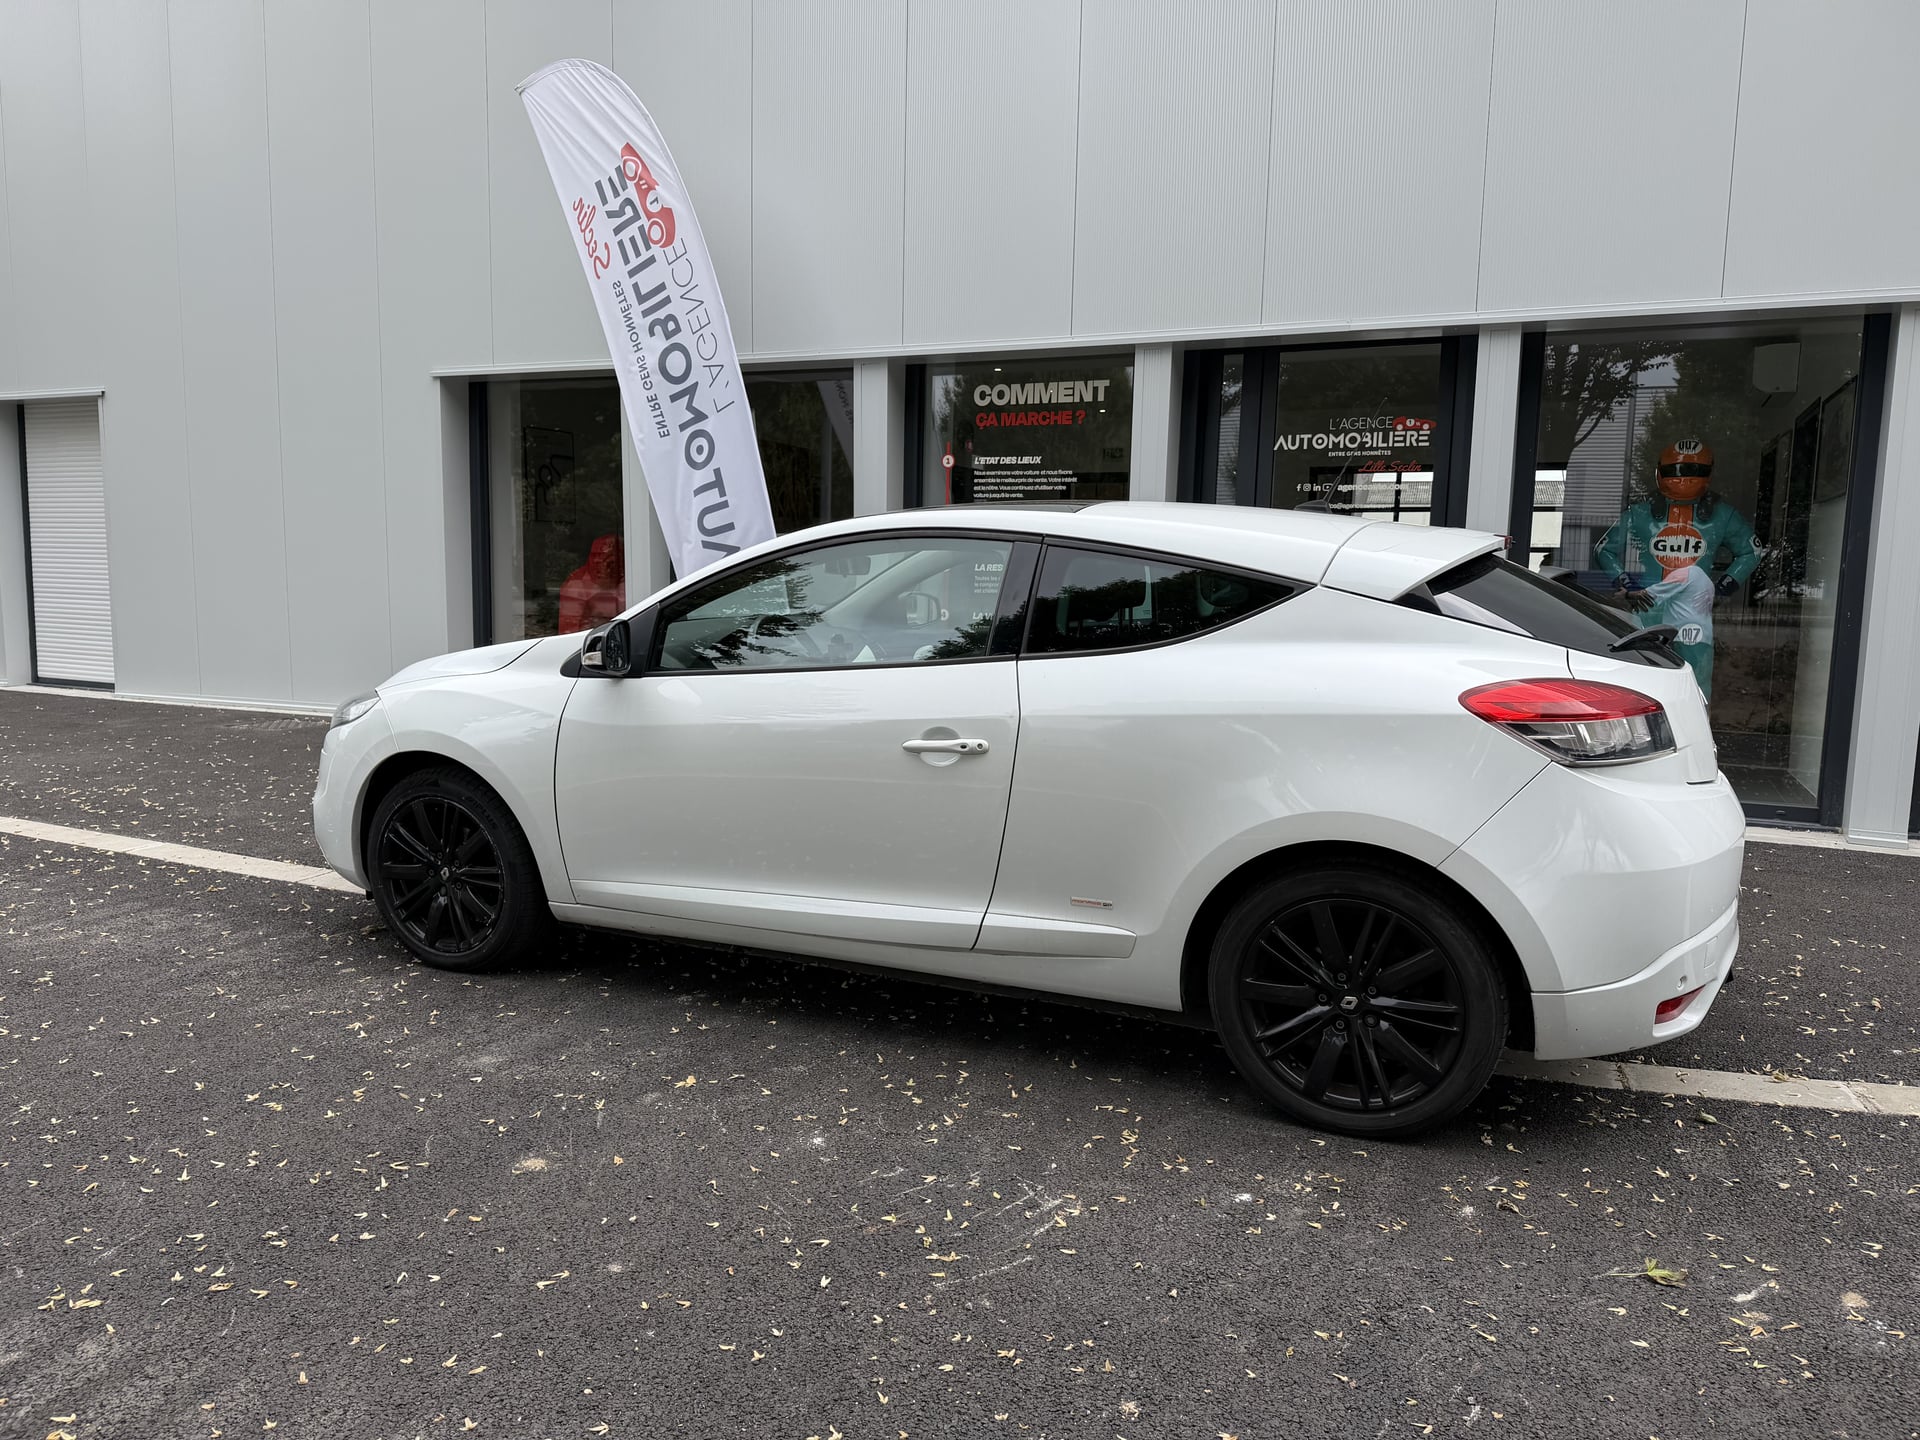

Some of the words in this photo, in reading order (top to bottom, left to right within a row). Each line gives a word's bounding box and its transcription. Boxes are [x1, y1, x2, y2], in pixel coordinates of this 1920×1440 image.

[973, 379, 1110, 407] COMMENT
[975, 412, 998, 430] ÇA
[1001, 410, 1073, 427] MARCHE
[1076, 409, 1087, 425] ?
[1329, 416, 1393, 431] L'AGENCE
[974, 456, 1000, 465] L'ETAT
[1000, 456, 1017, 465] DES
[1017, 456, 1042, 465] LIEUX
[1388, 459, 1422, 472] Seclin
[1653, 539, 1703, 554] Gulf
[974, 563, 986, 572] LA
[1681, 627, 1701, 640] 007
